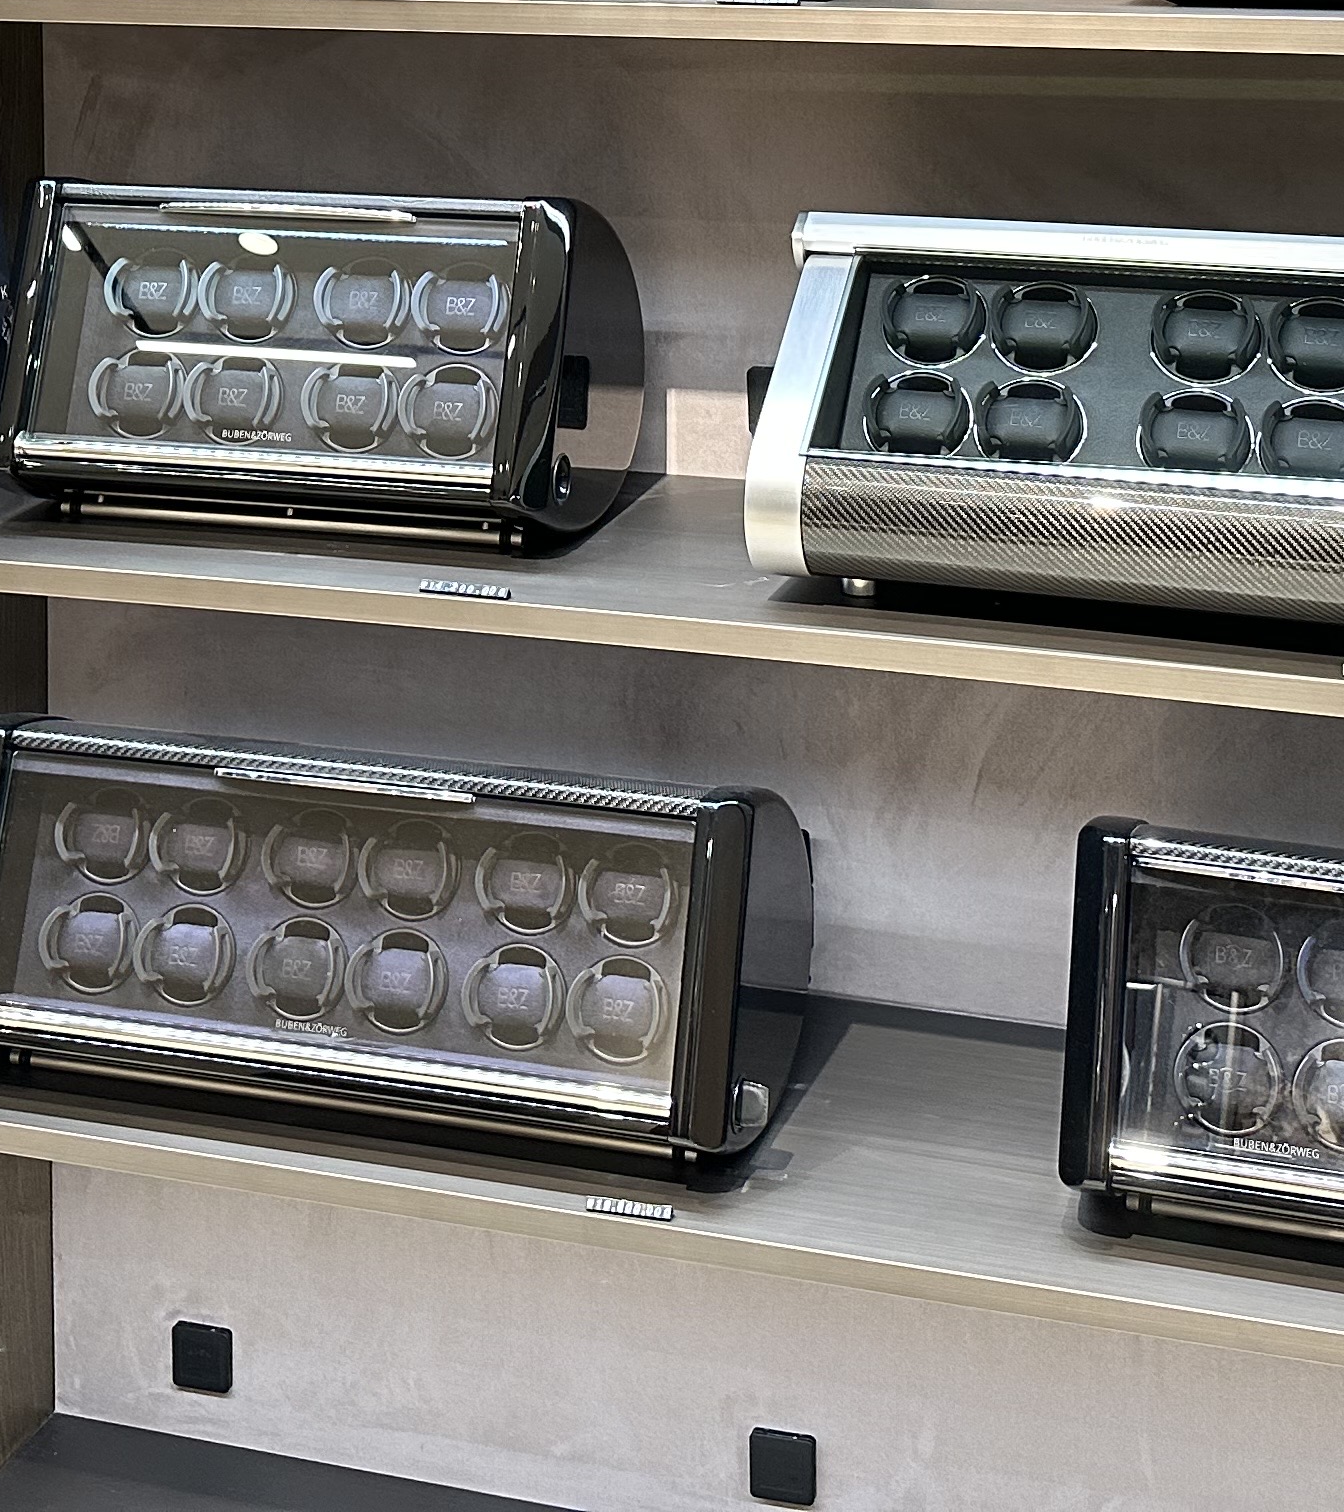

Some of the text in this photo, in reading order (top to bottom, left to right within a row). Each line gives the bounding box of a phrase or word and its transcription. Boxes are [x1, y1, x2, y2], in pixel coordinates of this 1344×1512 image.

[138, 281, 168, 301] B&Z
[349, 291, 379, 310] B&Z
[445, 297, 476, 316] B&Z
[124, 382, 153, 402] B&Z
[218, 388, 248, 408] B&Z
[335, 394, 366, 415] B&Z
[433, 401, 463, 421] B&Z
